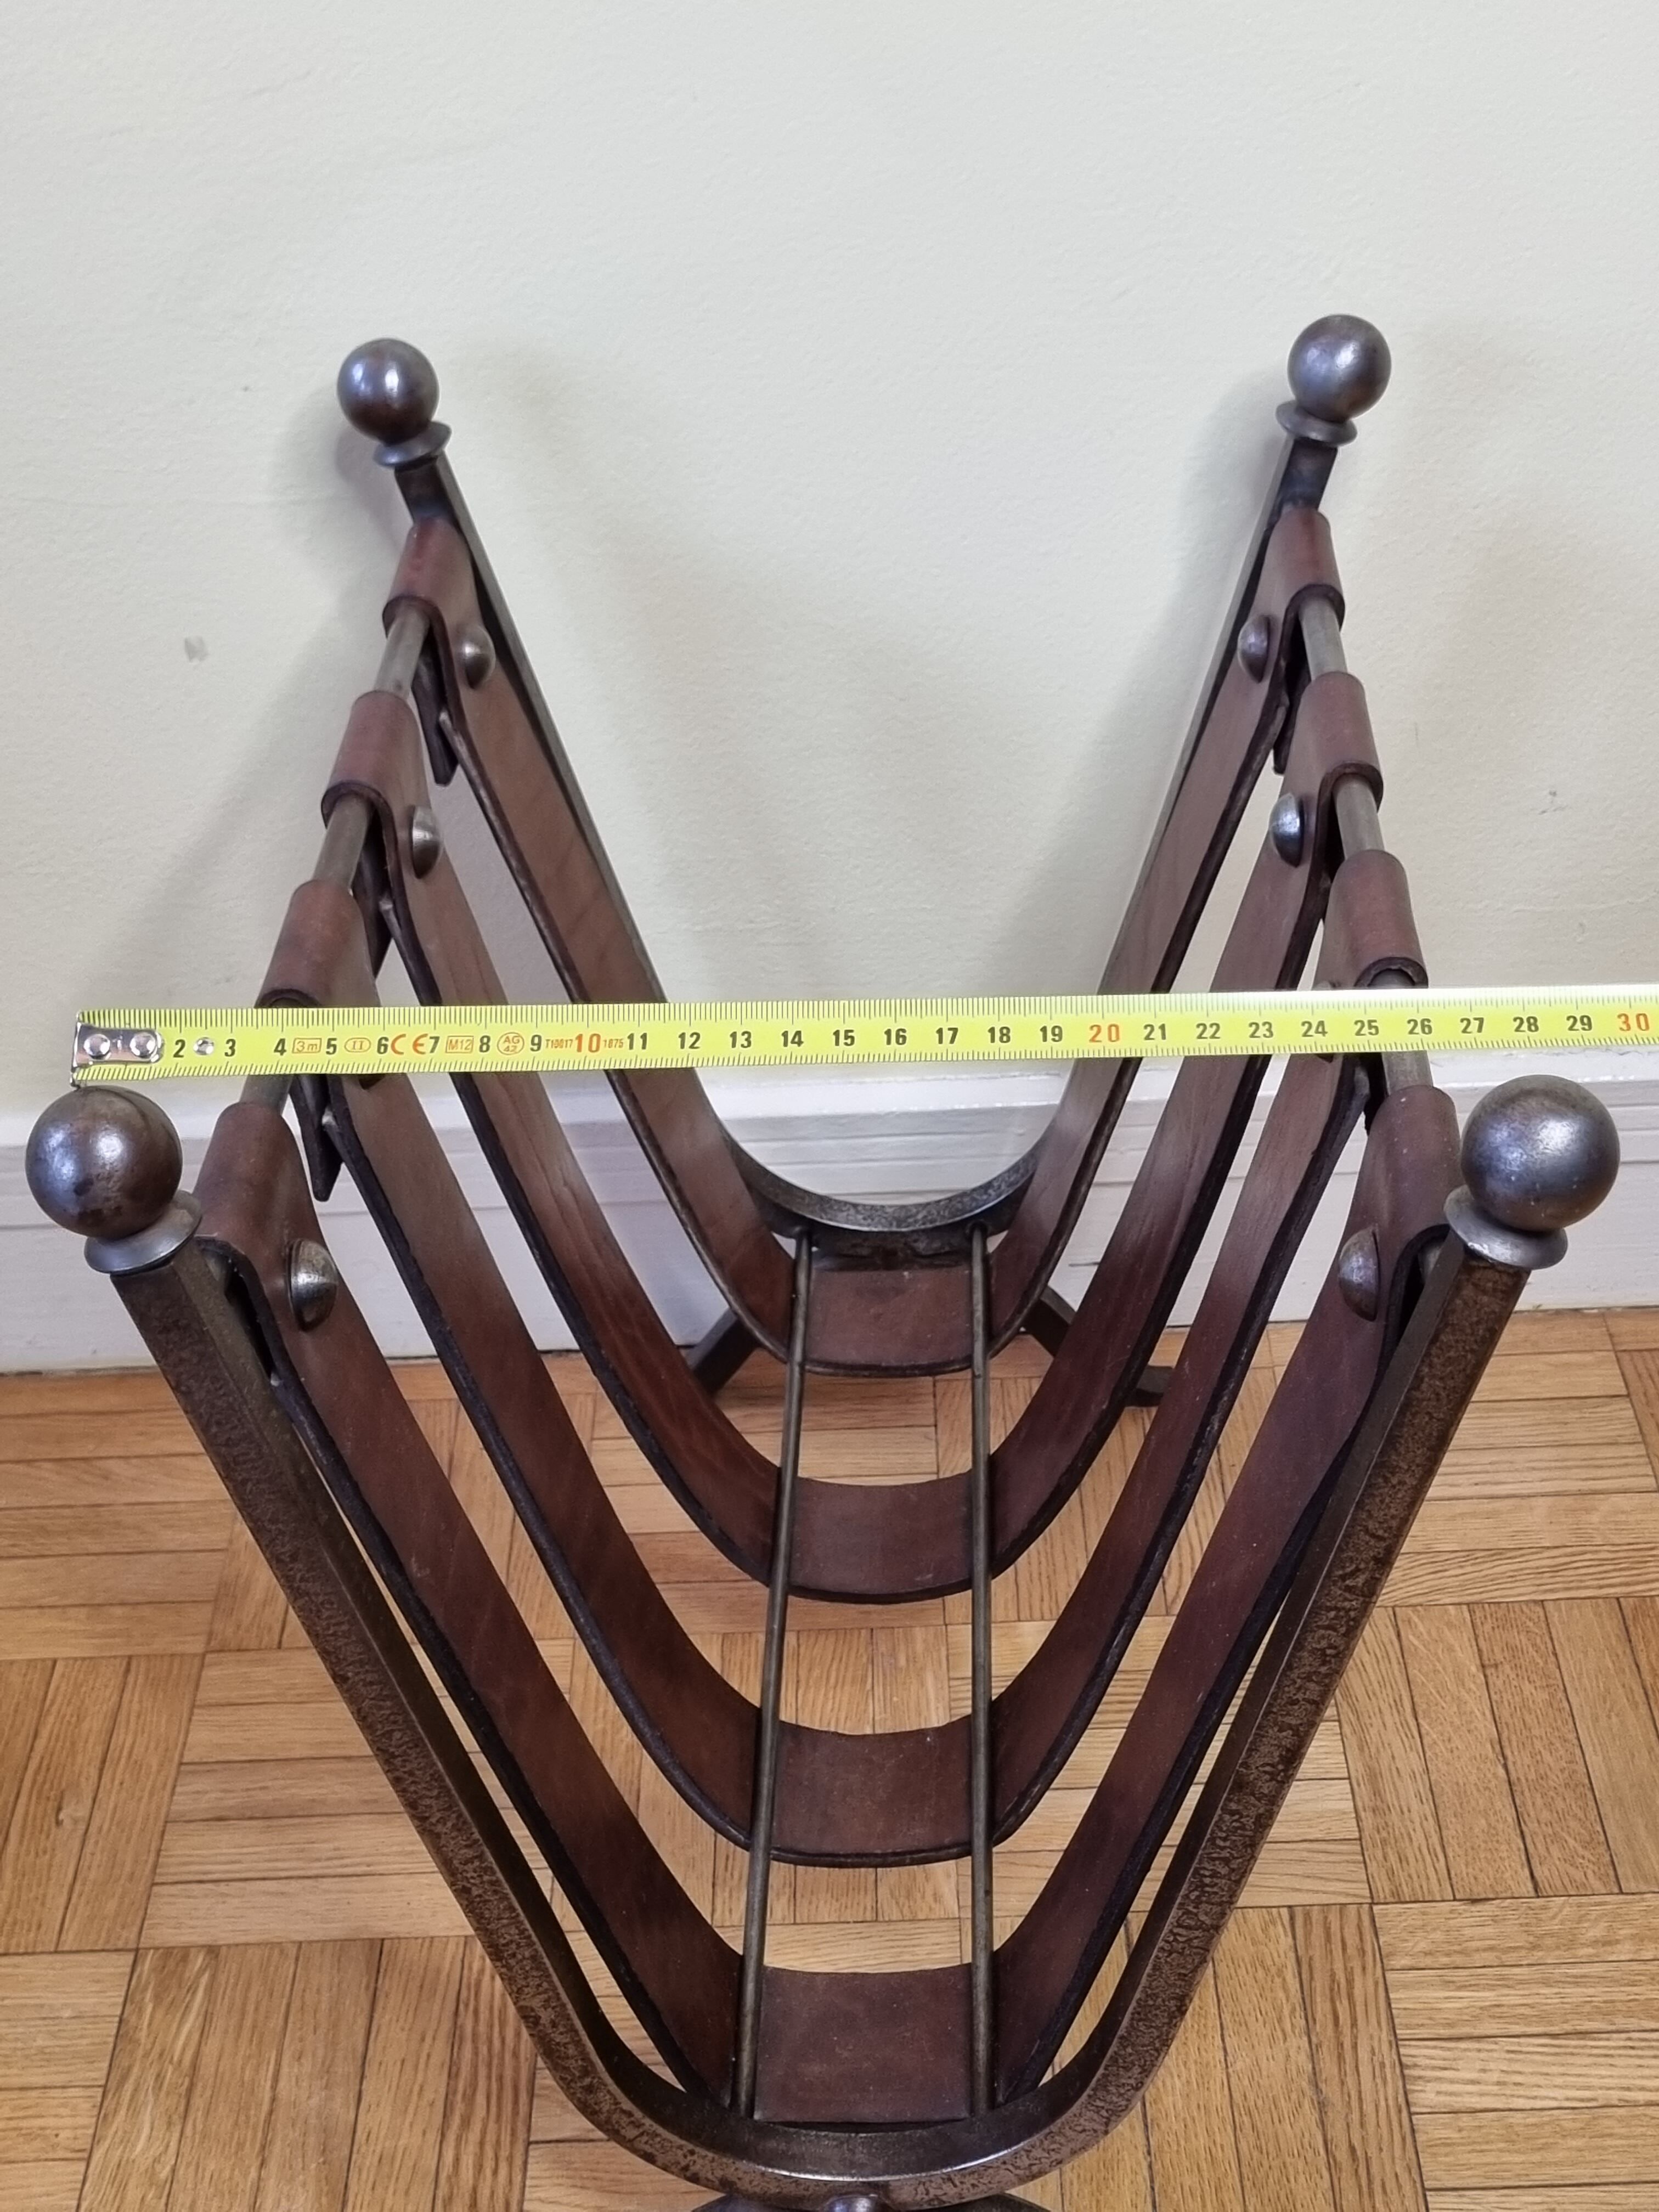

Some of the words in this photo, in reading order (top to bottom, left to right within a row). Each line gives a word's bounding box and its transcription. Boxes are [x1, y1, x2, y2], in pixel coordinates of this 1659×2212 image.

[173, 1039, 185, 1058] 2
[224, 1039, 235, 1057] 3
[274, 1039, 286, 1056] 4
[326, 1038, 337, 1055] 5
[377, 1037, 388, 1054] 6
[390, 1033, 428, 1055] CE
[430, 1036, 440, 1053] 7
[448, 1038, 472, 1052] M12
[479, 1035, 490, 1053] 8
[530, 1035, 541, 1052] 9
[575, 1034, 601, 1053] 10
[628, 1033, 647, 1050] 11
[679, 1032, 700, 1049] 12
[730, 1031, 751, 1048] 13
[782, 1030, 804, 1047] 14
[833, 1030, 855, 1046] 15
[884, 1028, 907, 1045] 16
[936, 1028, 958, 1044] 17
[988, 1026, 1011, 1043] 18
[1040, 1025, 1063, 1042] 19
[1089, 1024, 1120, 1042] 20
[1144, 1024, 1166, 1040] 21
[1196, 1023, 1220, 1039] 22
[1249, 1022, 1273, 1038] 23
[1301, 1020, 1328, 1037] 24
[1354, 1019, 1379, 1036] 25
[1407, 1018, 1432, 1035] 26
[1460, 1017, 1484, 1034] 27
[1513, 1016, 1539, 1032] 28
[1566, 1015, 1592, 1031] 29
[1617, 1013, 1649, 1031] 30
